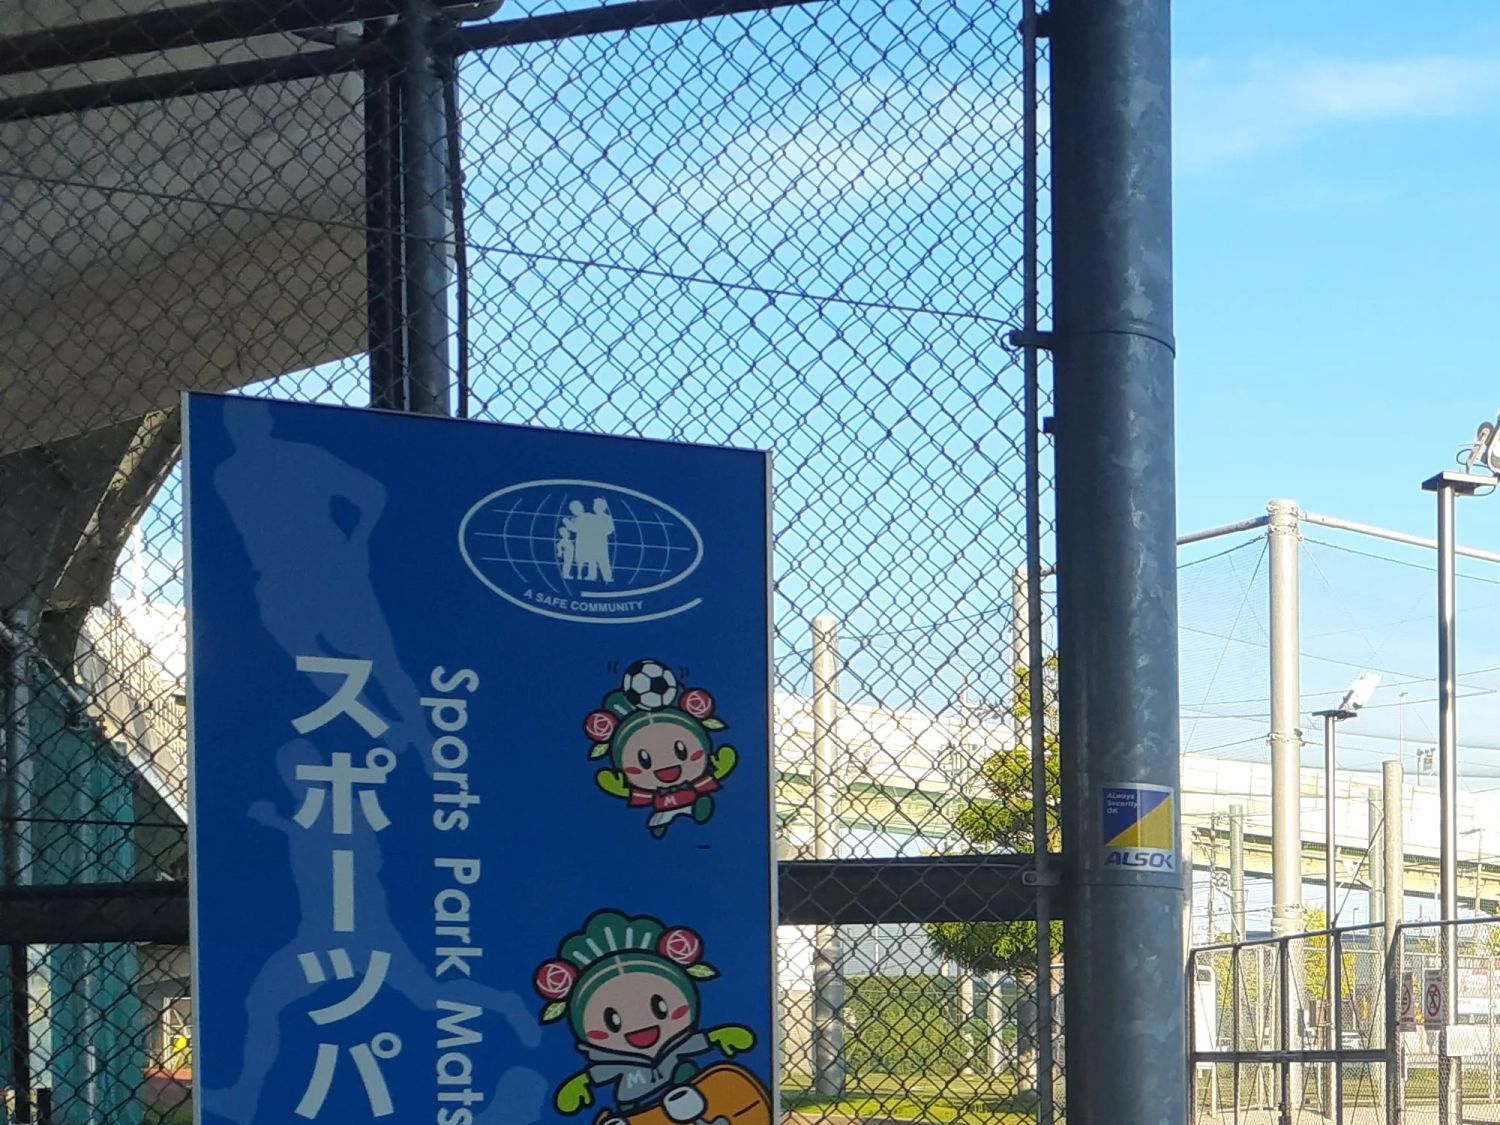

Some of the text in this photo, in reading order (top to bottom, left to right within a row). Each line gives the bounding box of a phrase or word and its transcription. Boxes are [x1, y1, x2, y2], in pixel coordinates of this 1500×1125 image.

[524, 589, 643, 613] A SAFE COMMUNITY
[420, 666, 482, 832] Sports
[664, 796, 678, 806] M
[1103, 851, 1173, 870] ALSOK
[434, 858, 484, 977] Park
